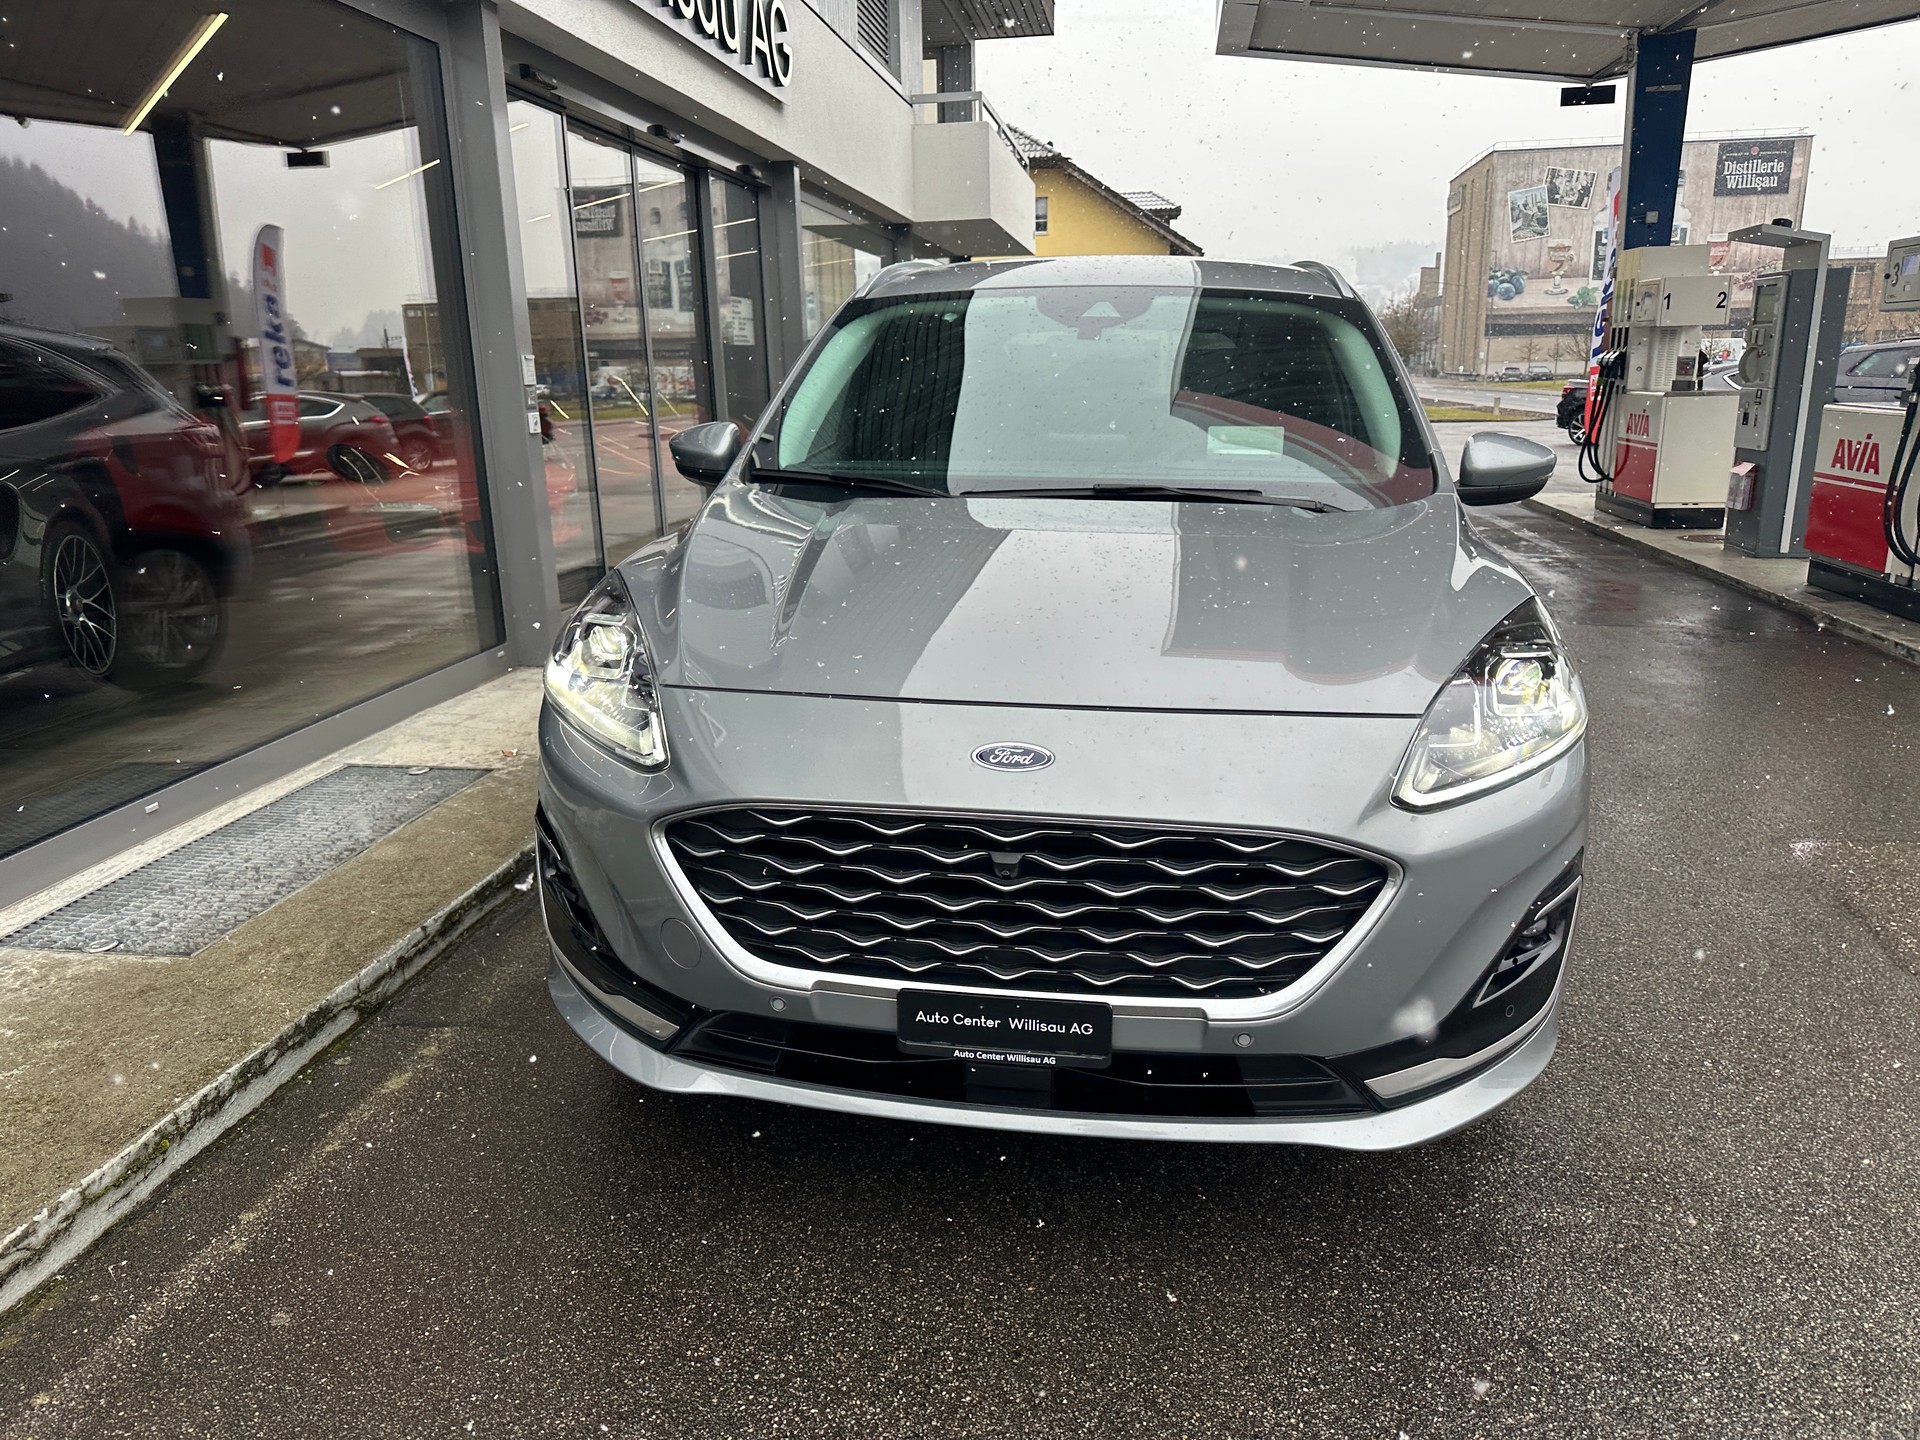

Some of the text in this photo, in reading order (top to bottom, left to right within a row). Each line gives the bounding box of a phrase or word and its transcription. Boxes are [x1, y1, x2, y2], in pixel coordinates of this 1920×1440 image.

[751, 0, 793, 87] AG
[1723, 159, 1785, 175] Distillerie
[1726, 174, 1778, 191] Willisau
[1891, 261, 1900, 287] 3
[1663, 291, 1728, 310] 1 2
[1830, 433, 1880, 476] AVIA
[989, 747, 1035, 765] Ford
[915, 1010, 1094, 1035] Auto Center Willisau AG
[953, 1049, 1057, 1066] Auto Center Willisau AG
